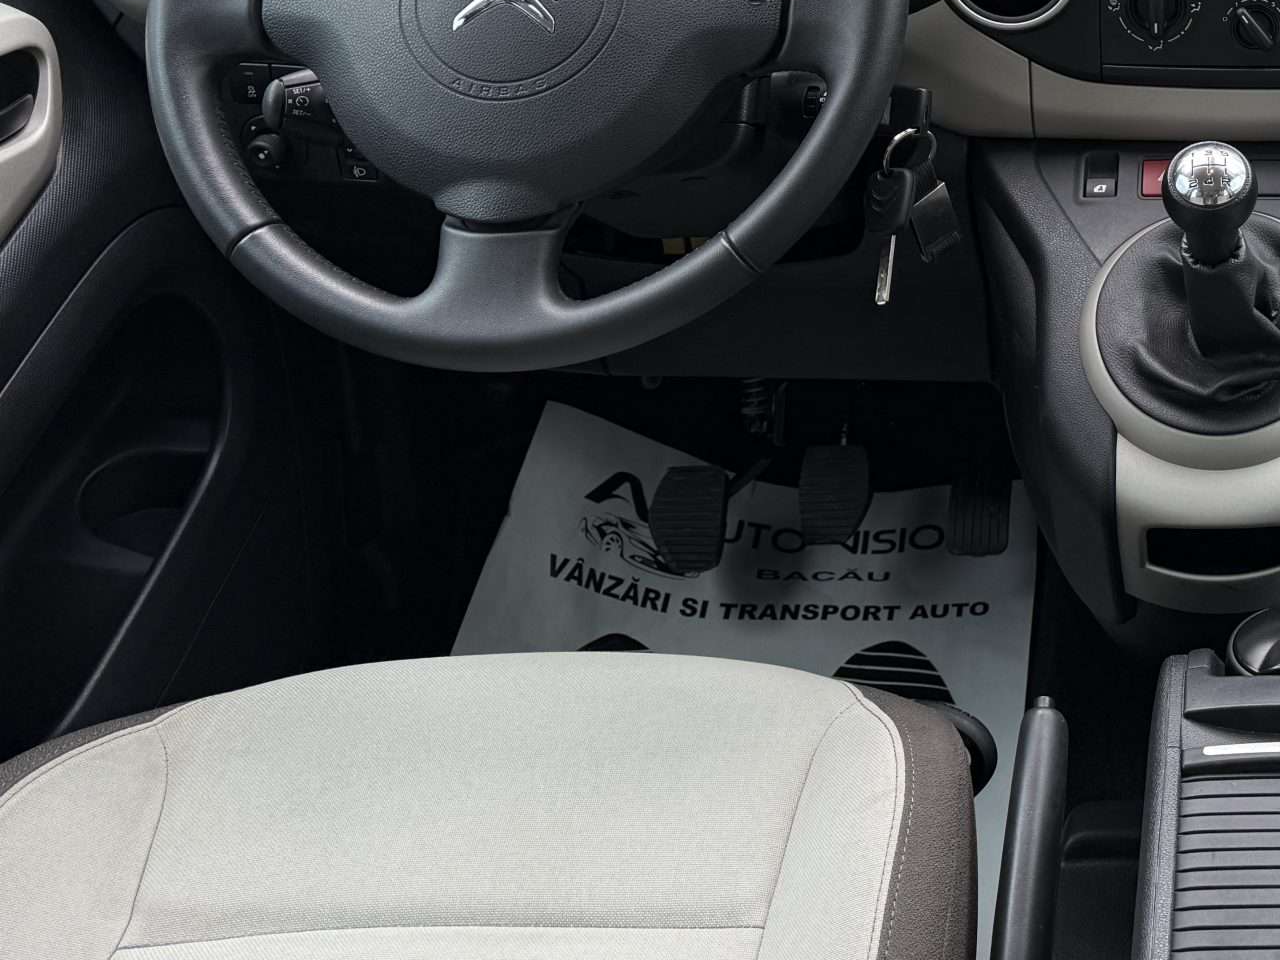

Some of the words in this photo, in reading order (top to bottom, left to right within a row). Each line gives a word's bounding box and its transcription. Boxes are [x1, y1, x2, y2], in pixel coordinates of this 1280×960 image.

[550, 553, 671, 614] VÂNZĂRI
[679, 597, 710, 620] SI
[719, 602, 902, 622] TRANSPORT
[909, 601, 990, 621] AUTO
[755, 566, 891, 582] BACĂU
